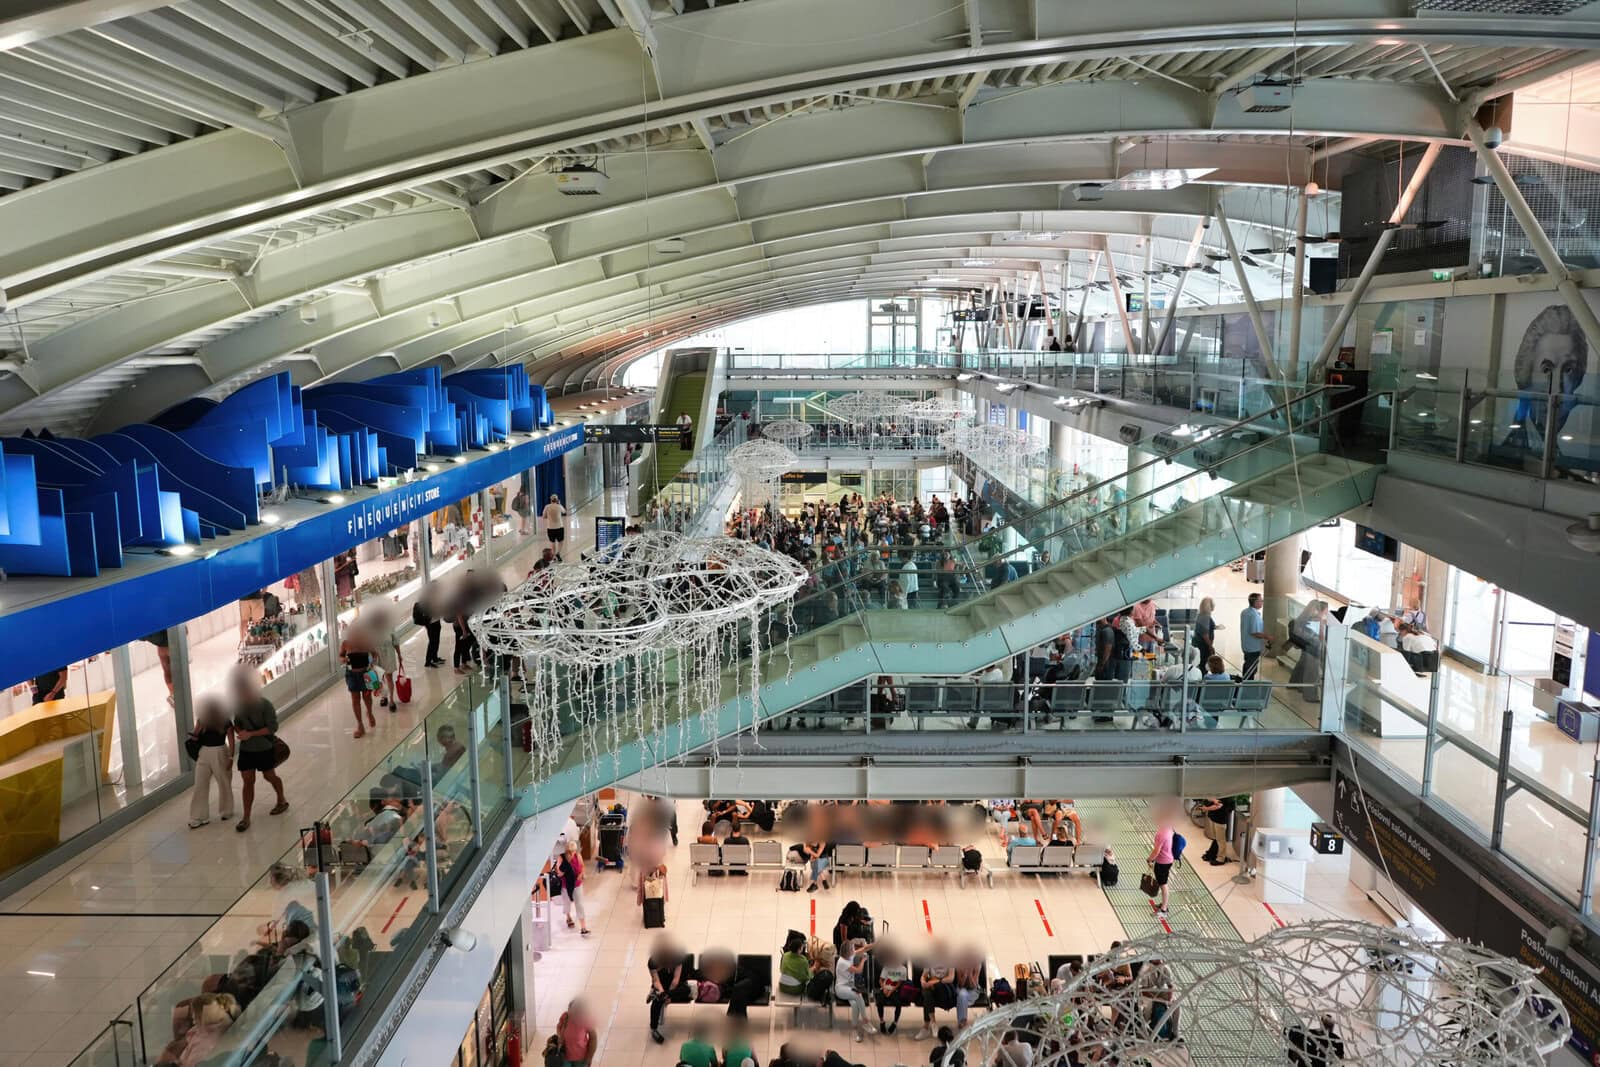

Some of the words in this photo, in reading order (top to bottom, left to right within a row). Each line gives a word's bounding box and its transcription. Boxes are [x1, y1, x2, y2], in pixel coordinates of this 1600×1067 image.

[347, 494, 421, 534] FREQUENCY
[424, 487, 440, 502] STORE
[1327, 839, 1336, 852] 8
[1520, 928, 1560, 969] Poslovni
[1559, 962, 1590, 994] saloni
